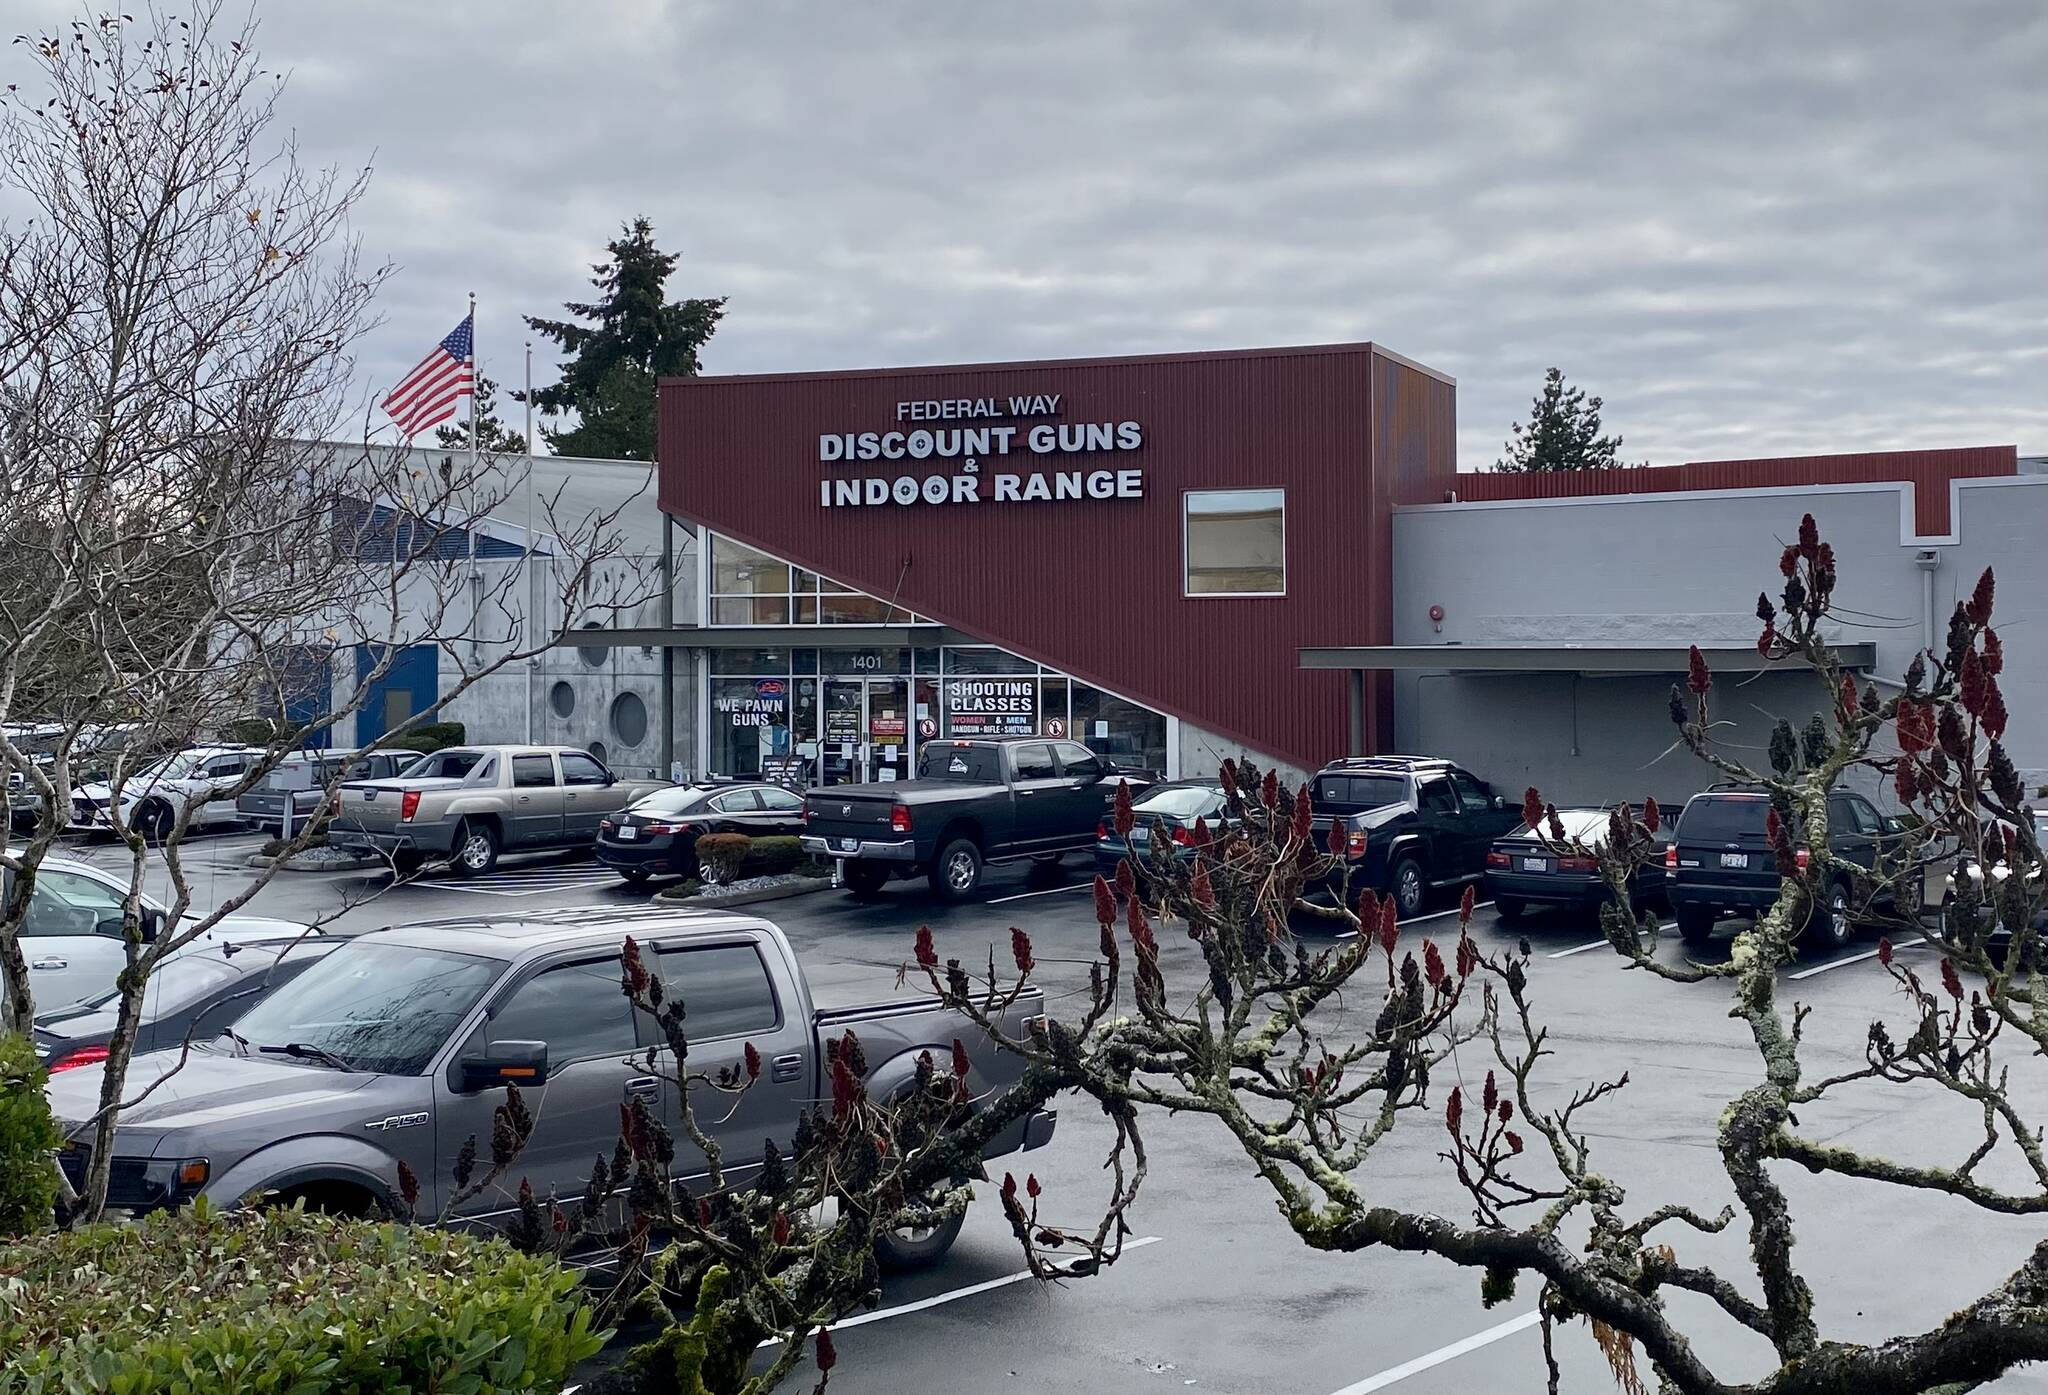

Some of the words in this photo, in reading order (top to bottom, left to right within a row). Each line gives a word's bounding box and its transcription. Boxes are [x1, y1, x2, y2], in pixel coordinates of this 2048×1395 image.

[896, 398, 1002, 421] FEDERAL
[1008, 394, 1061, 416] WAY
[819, 426, 1017, 461] DISCOUNT
[1027, 421, 1142, 454] GUNS
[963, 458, 979, 473] &
[821, 475, 980, 507] INDOOR
[994, 469, 1143, 502] RANGE
[851, 656, 882, 669] 1401
[951, 682, 1032, 696] SHOOTING
[719, 699, 740, 712] WE
[745, 699, 783, 712] PAWN
[950, 697, 1032, 711] CLASSES
[732, 713, 769, 726] GUNS
[951, 716, 986, 724] WOMEN
[995, 716, 1002, 724] &
[1006, 716, 1027, 724] MEN
[951, 725, 980, 734] HANDGUN
[983, 725, 1000, 734] RIFLE
[1004, 725, 1033, 734] SHOTGUN
[366, 1111, 429, 1130] F150
